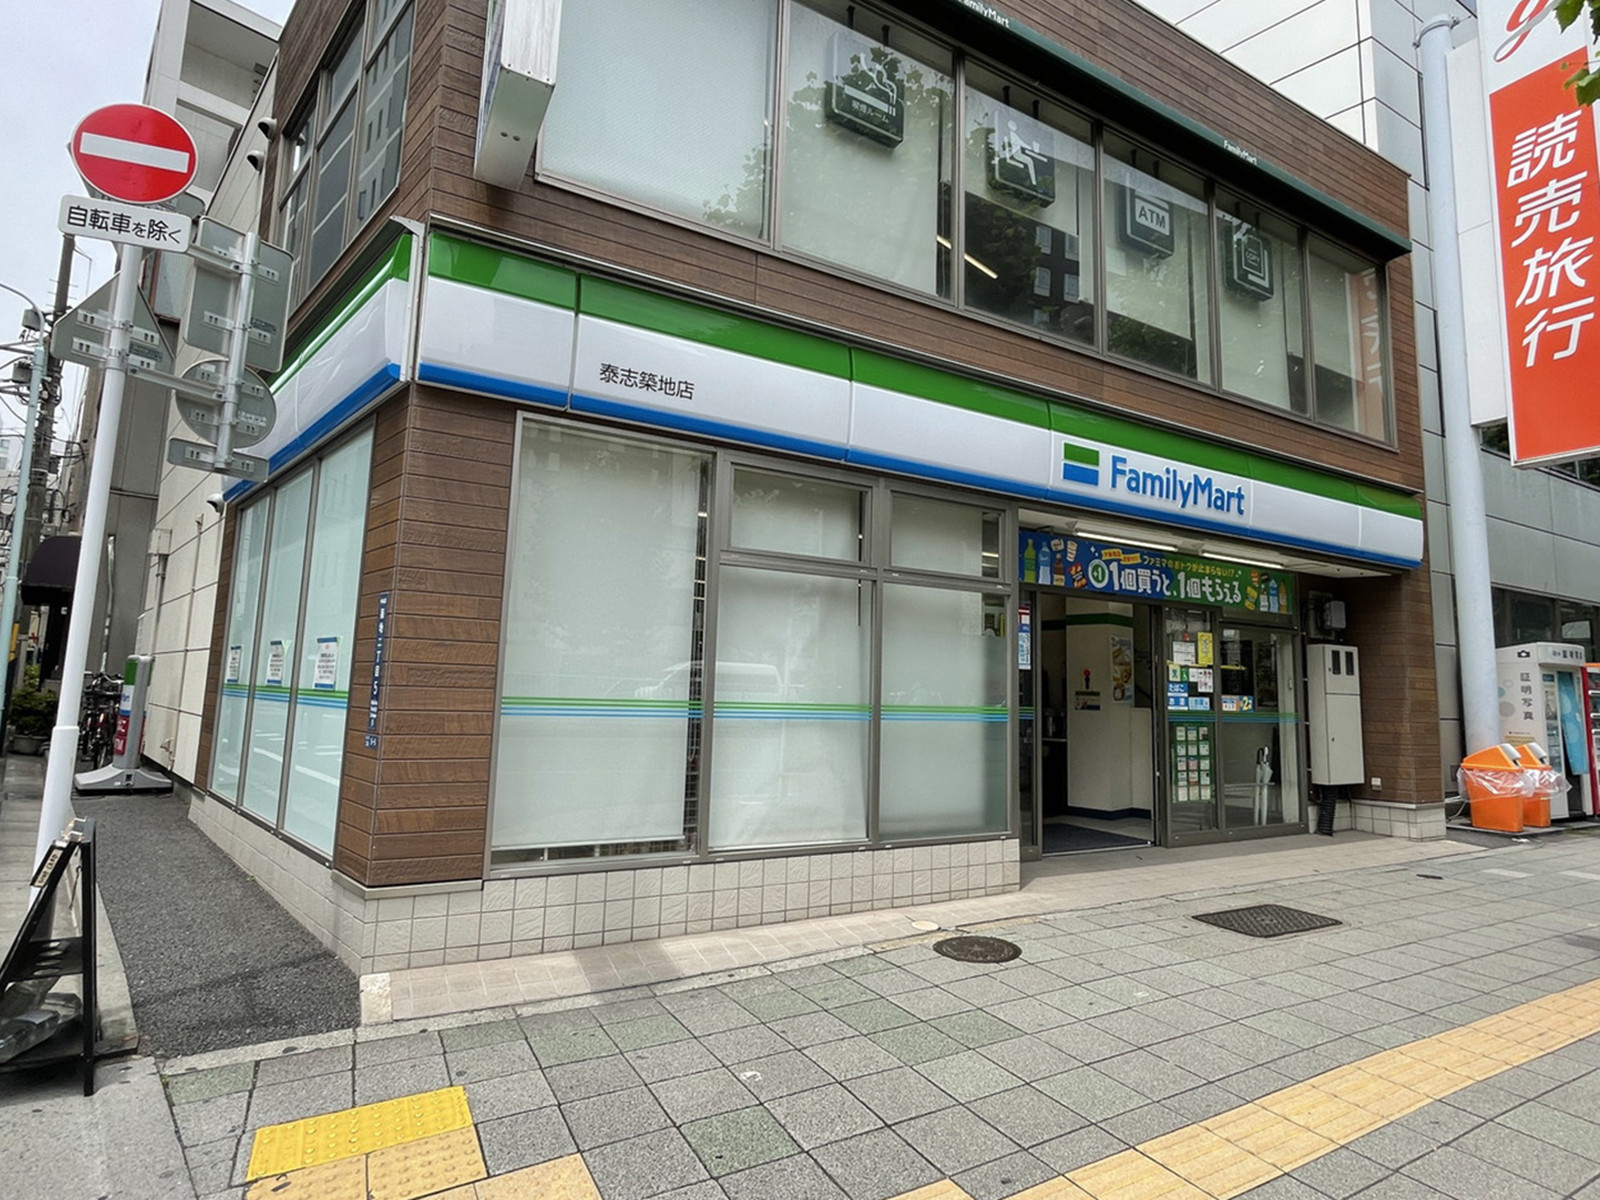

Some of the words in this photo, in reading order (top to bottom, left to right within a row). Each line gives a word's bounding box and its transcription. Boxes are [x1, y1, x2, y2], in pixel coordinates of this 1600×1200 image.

[958, 0, 1010, 28] amilyMart
[67, 204, 182, 245] 自転車を除く
[1138, 205, 1166, 229] ATM
[1507, 109, 1596, 368] 読売旅行
[600, 362, 695, 400] 泰志築地店
[1110, 454, 1246, 516] FamilyMart
[1109, 561, 1242, 604] 1個買うと、1個もらえる
